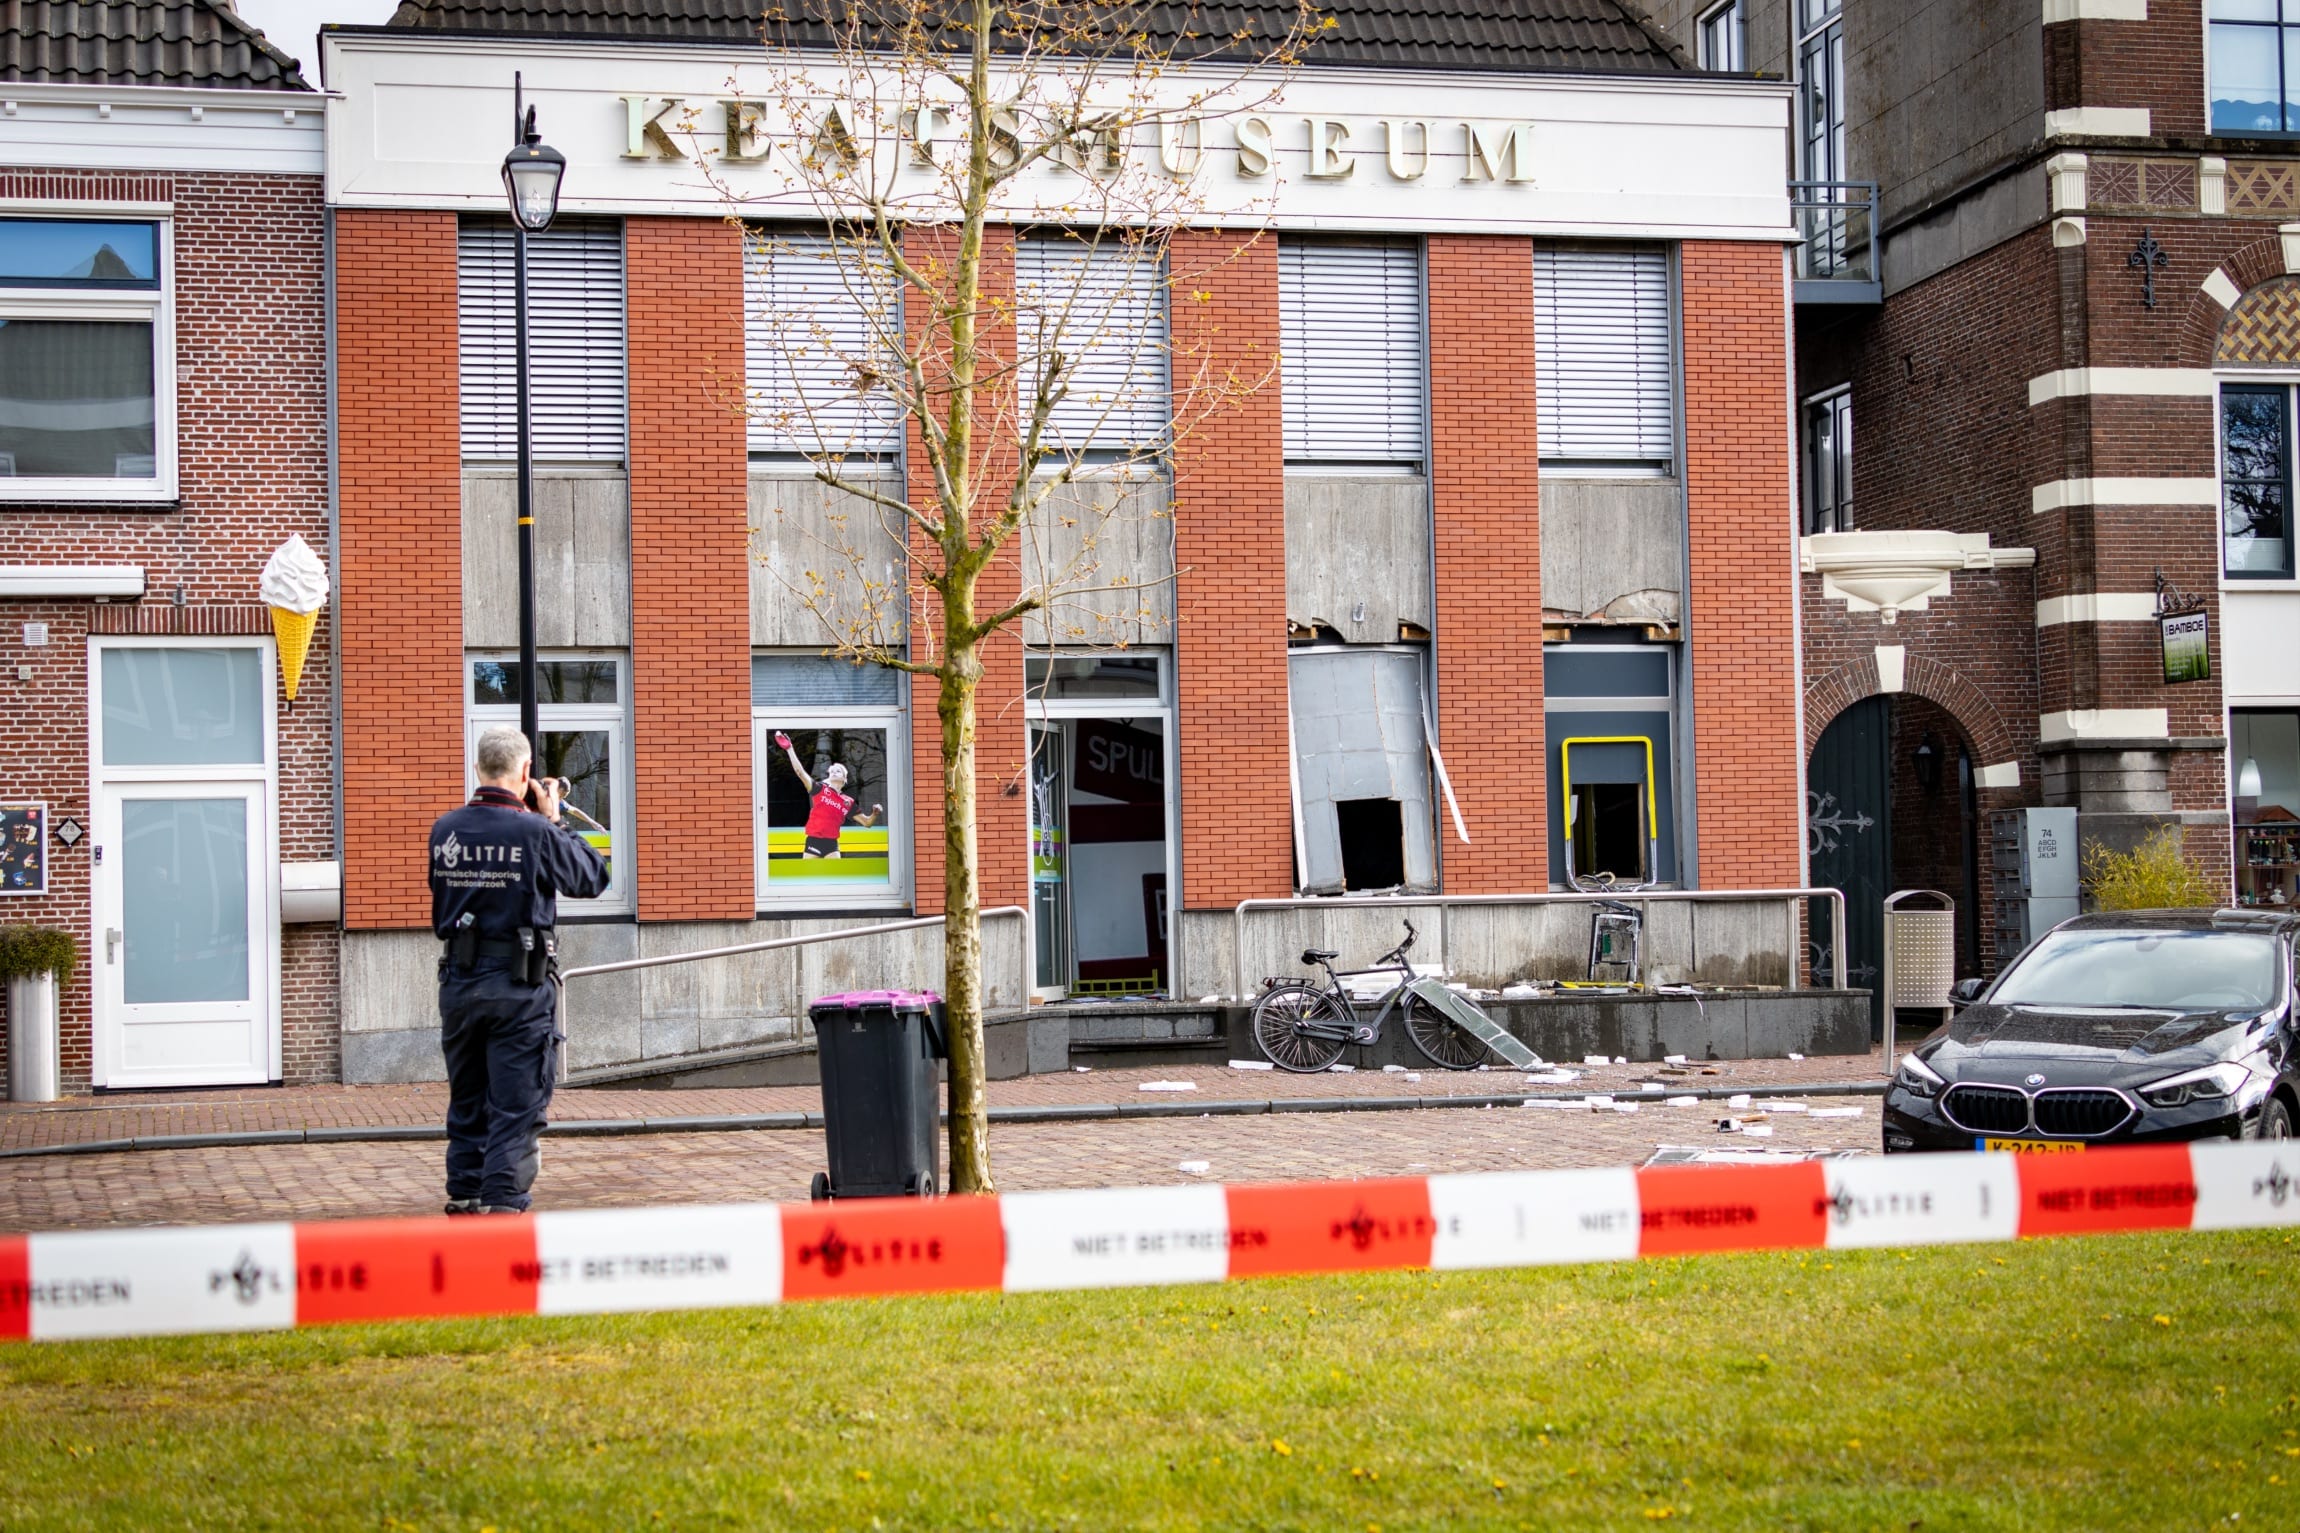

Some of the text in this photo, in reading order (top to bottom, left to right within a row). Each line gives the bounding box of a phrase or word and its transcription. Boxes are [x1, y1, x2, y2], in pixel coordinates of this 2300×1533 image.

[2041, 829, 2052, 838] 74
[1072, 1230, 1129, 1257] NIET
[582, 1252, 729, 1281] BETREDEN
